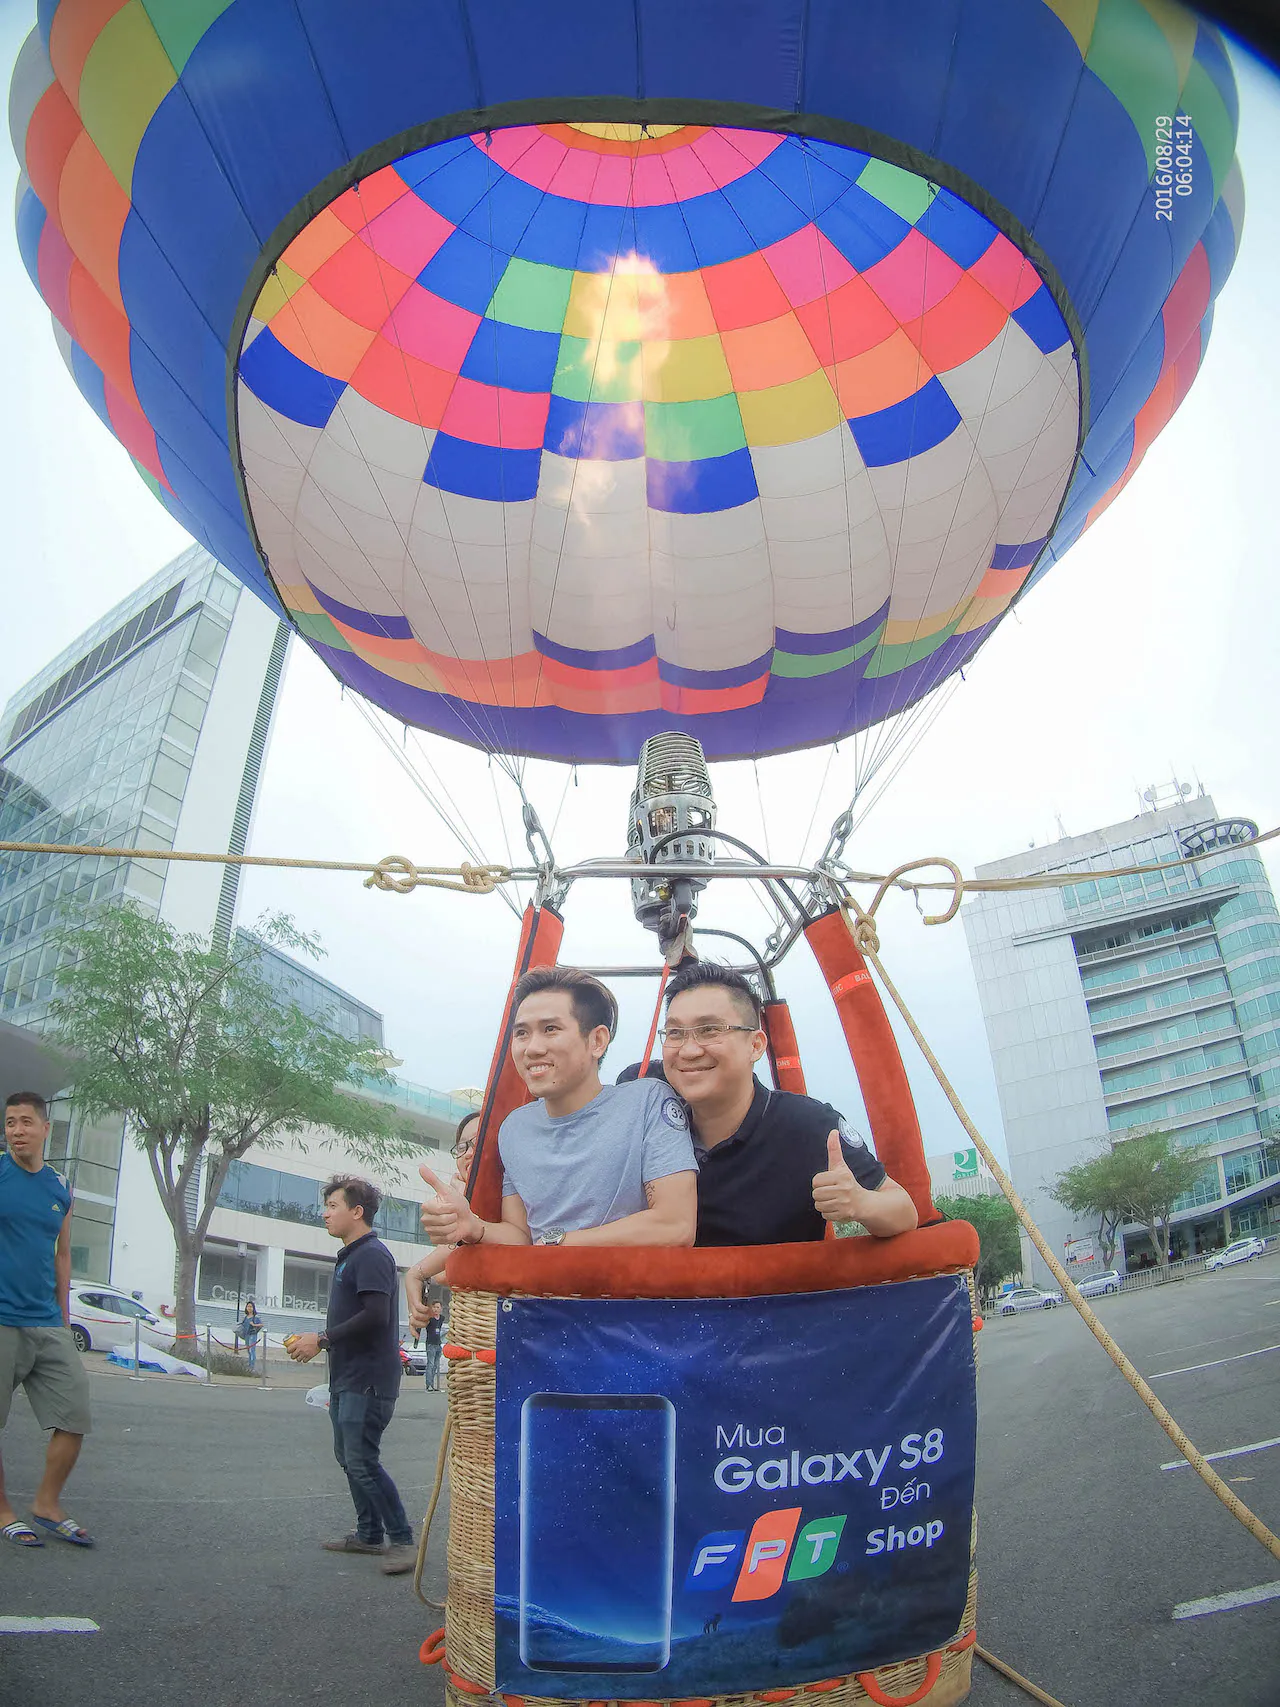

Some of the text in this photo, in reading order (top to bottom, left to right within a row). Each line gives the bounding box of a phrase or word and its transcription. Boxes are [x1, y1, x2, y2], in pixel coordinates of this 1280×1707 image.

[671, 1107, 685, 1121] 32
[211, 1285, 319, 1312] Crescent Plaza
[715, 1423, 786, 1449] Mua
[713, 1427, 944, 1493] Galaxy S8
[880, 1476, 931, 1510] Đến
[865, 1519, 945, 1555] Shop
